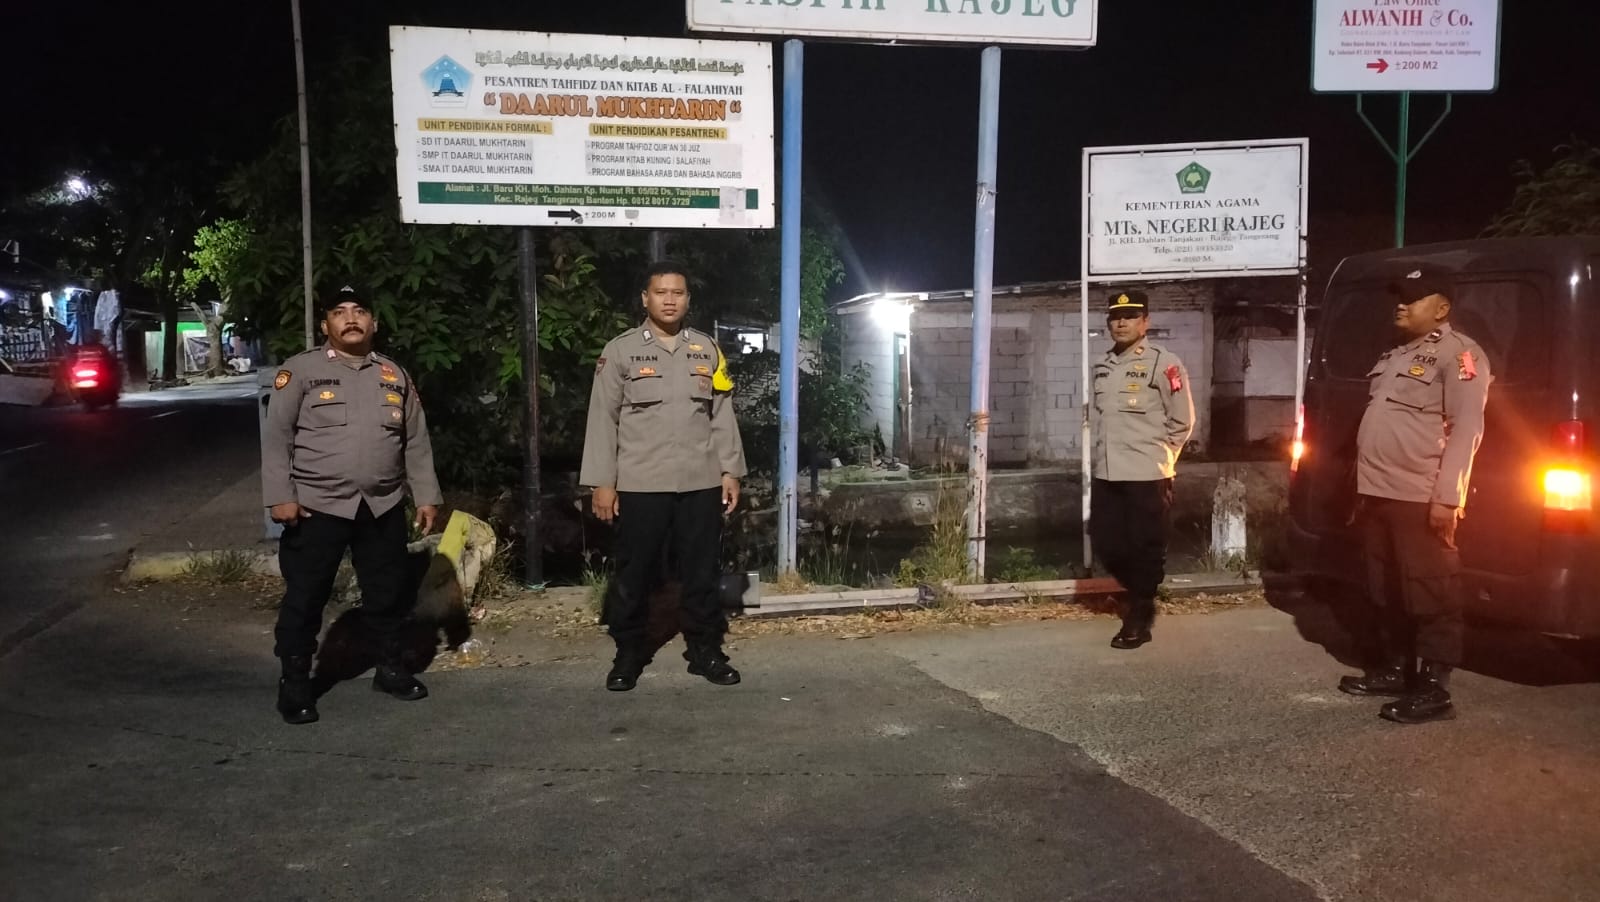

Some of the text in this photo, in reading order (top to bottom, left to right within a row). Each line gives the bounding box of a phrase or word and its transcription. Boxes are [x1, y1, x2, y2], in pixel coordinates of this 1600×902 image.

[1339, 9, 1423, 27] ALWANIH
[1447, 9, 1473, 27] Co.
[1422, 61, 1439, 70] M2
[484, 76, 548, 89] PESANTREN
[550, 77, 598, 91] TAHFIDZ
[600, 80, 623, 92] DAN
[626, 81, 658, 92] KITAB
[661, 82, 675, 94] AL
[684, 83, 743, 96] FALAHIYAH
[499, 92, 594, 117] DAARUL
[595, 95, 726, 121] MUKHTARIN
[424, 120, 446, 130] UNIT
[448, 121, 503, 132] PENDIDIKAN
[505, 122, 542, 133] FORMAL
[593, 125, 614, 135] UNIT
[616, 126, 668, 137] PENDIDIKAN
[670, 127, 719, 138] PESANTREN
[421, 137, 433, 146] SD
[434, 137, 443, 146] IT
[444, 138, 478, 147] DAARUL
[479, 138, 526, 148] MUKHTARIN
[591, 141, 625, 150] PROGRAM
[626, 142, 653, 151] TAHFIDZ
[688, 144, 701, 152] JUZ
[422, 150, 440, 160] SMP
[441, 151, 449, 160] IT
[450, 151, 484, 161] DAARUL
[485, 152, 533, 161] MUKHTARIN
[591, 155, 625, 164] PROGRAM
[626, 155, 645, 164] KITAB
[646, 156, 671, 165] KUNING
[676, 157, 711, 166] SALAFIYAH
[423, 164, 441, 173] SMA
[442, 164, 450, 173] IT
[451, 165, 485, 174] DAARUL
[486, 165, 533, 175] MUKHTARIN
[592, 168, 626, 177] PROGRAM
[626, 168, 654, 177] BAHASA
[654, 169, 673, 178] ARAB
[674, 169, 687, 178] DAN
[688, 169, 715, 179] BAHASA
[716, 170, 742, 180] INGGRIS
[445, 183, 475, 192] Alamat
[493, 184, 513, 192] Baru
[515, 185, 530, 193] KH.
[532, 185, 552, 193] Moh.
[554, 186, 583, 194] Dahlan
[584, 186, 597, 196] Kp.
[676, 188, 709, 198] Tanjakan
[514, 195, 538, 205] Rajeg
[542, 195, 585, 206] Tangerang
[586, 196, 615, 205] Banten
[1125, 198, 1261, 211] KEMENTERIAN AGAMA
[607, 211, 616, 219] M
[1104, 214, 1285, 236] MTs. NEGERI RAJEG
[1138, 235, 1167, 244] Dahlan
[686, 353, 711, 361] POLRI
[1413, 354, 1438, 366] POLRI
[1125, 371, 1149, 379] POLRI
